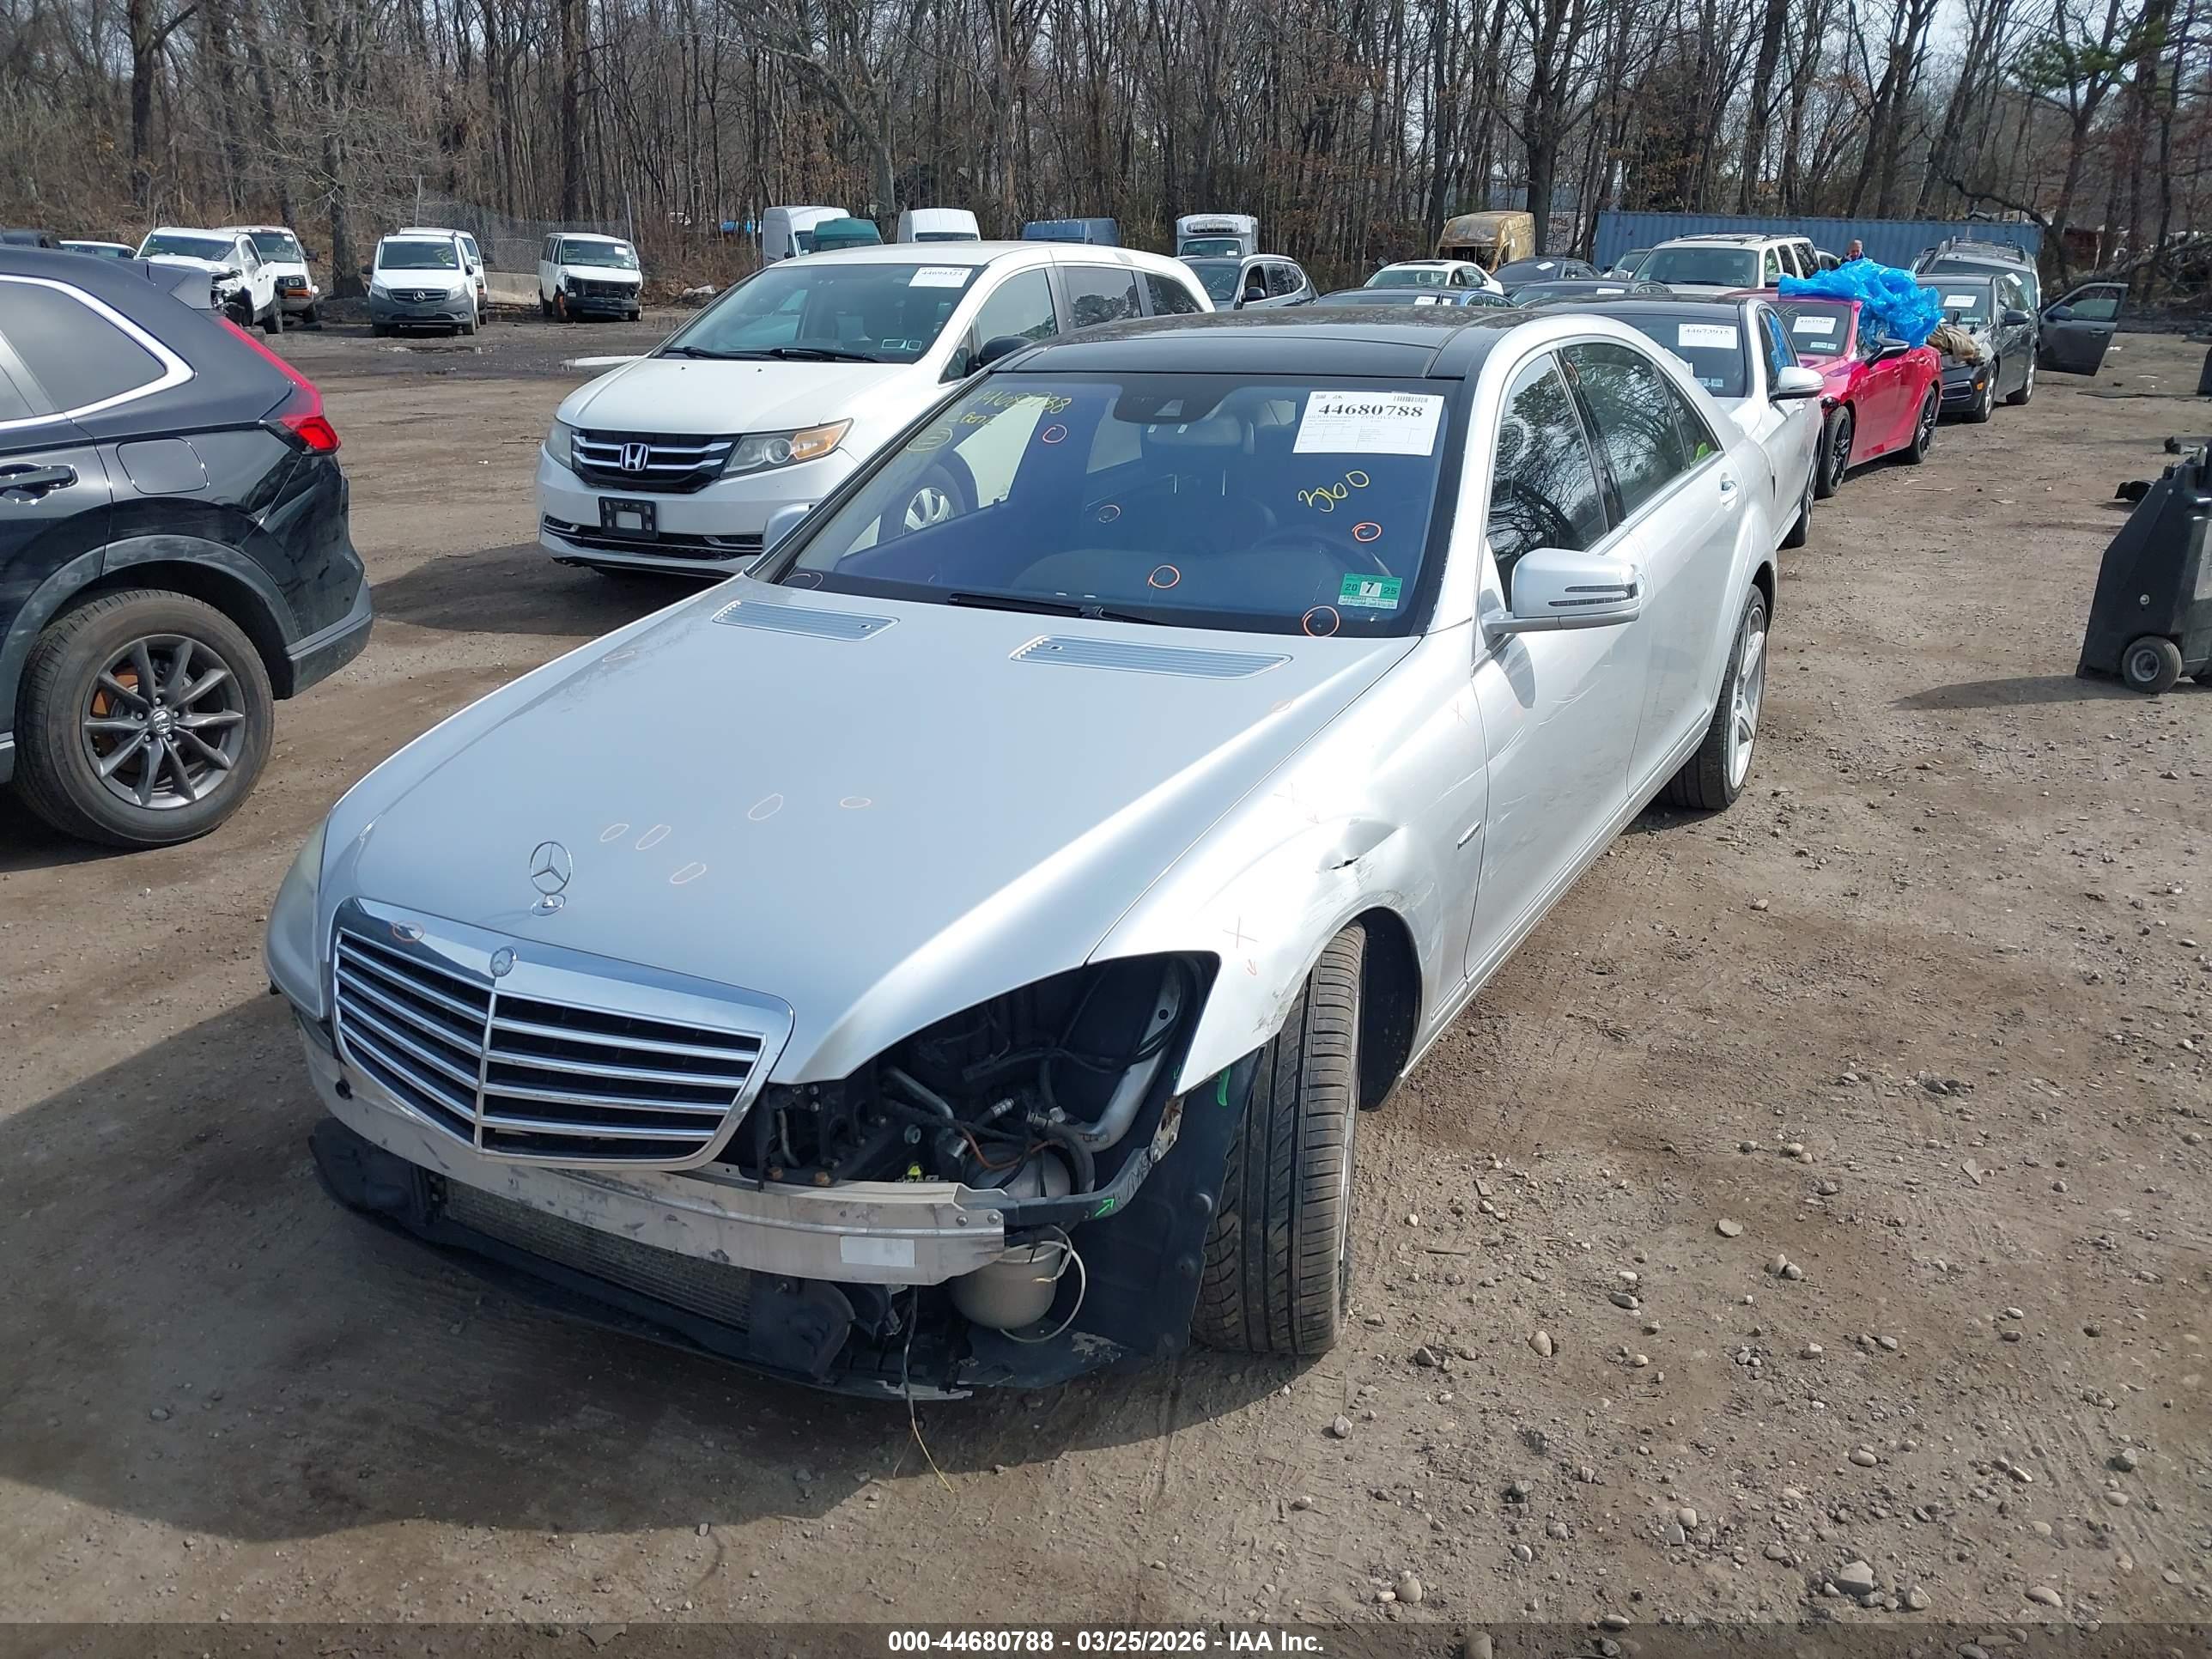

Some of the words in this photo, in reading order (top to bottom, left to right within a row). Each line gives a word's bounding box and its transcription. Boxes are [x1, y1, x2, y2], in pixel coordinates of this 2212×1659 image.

[1318, 404, 1424, 418] 44680788
[1344, 583, 1358, 592] 20
[1365, 581, 1375, 594] 7
